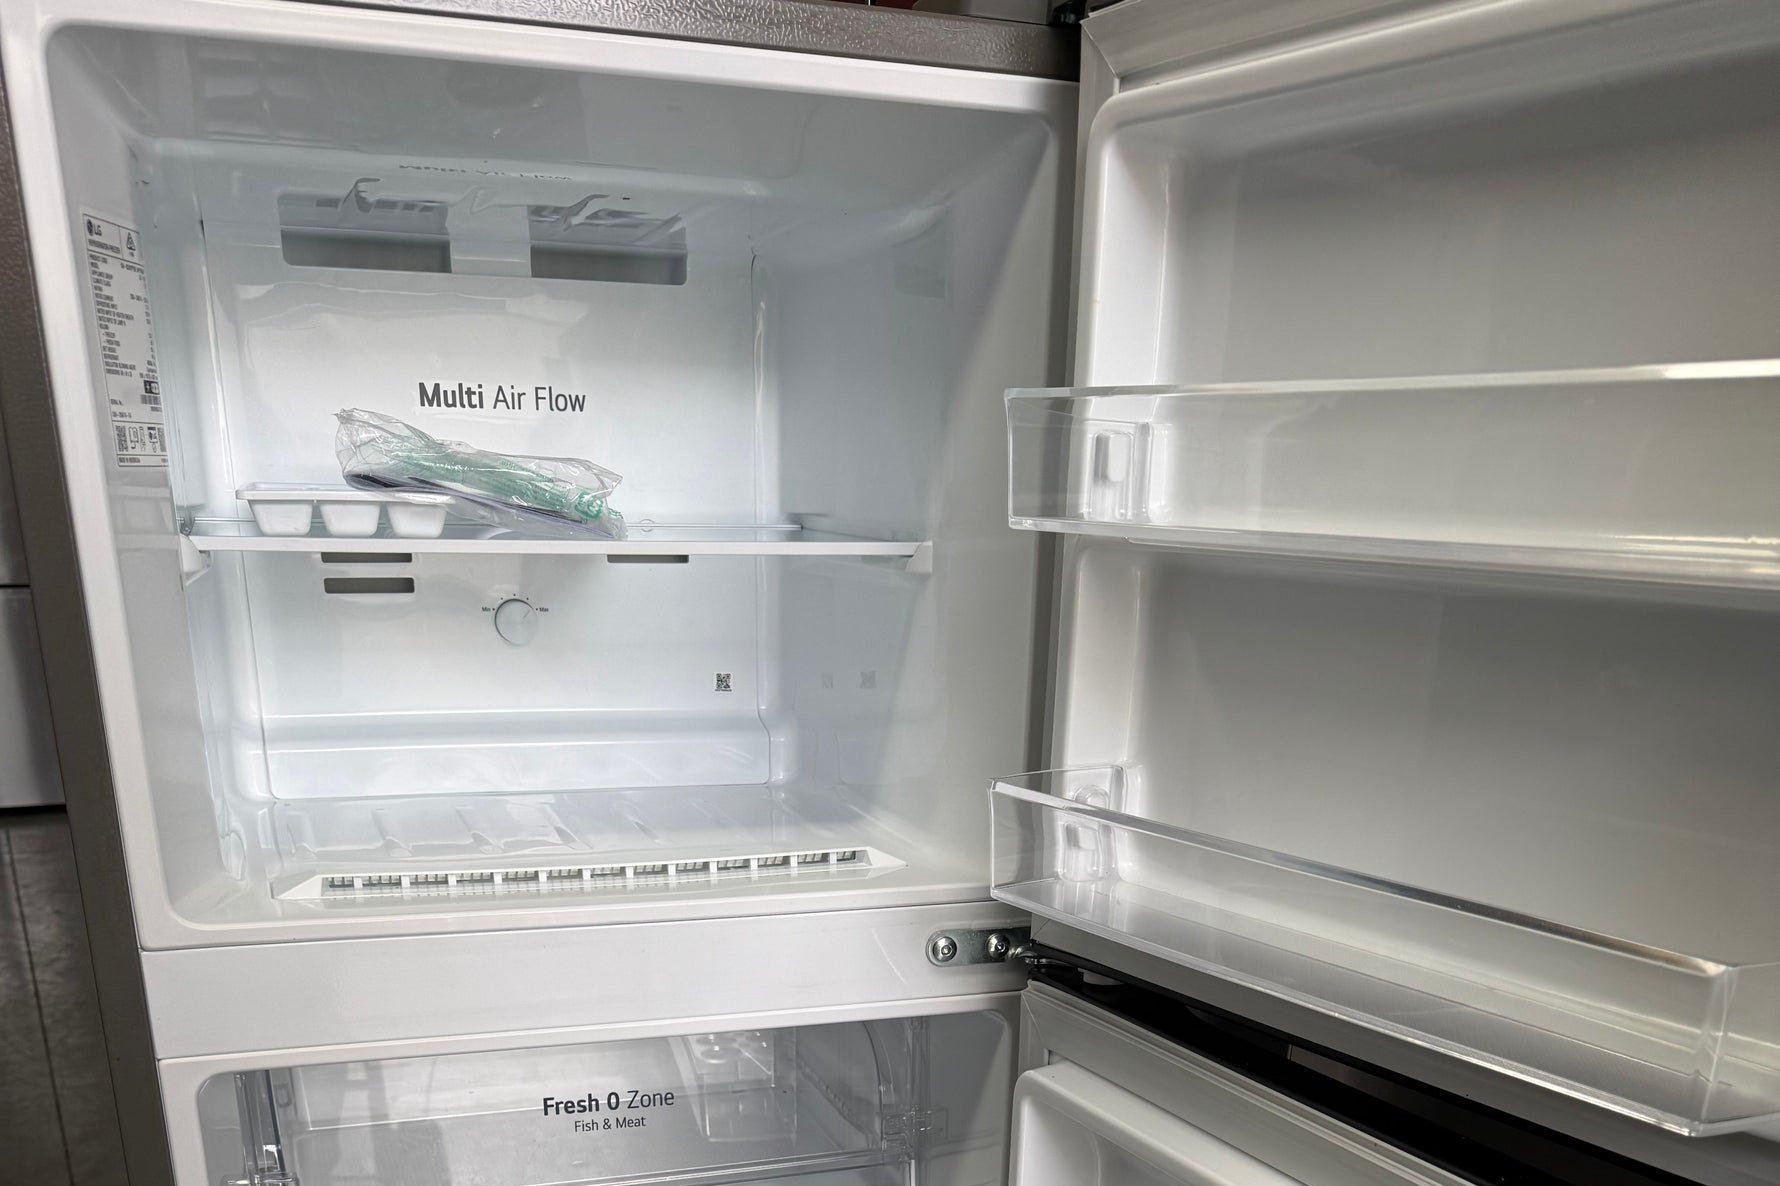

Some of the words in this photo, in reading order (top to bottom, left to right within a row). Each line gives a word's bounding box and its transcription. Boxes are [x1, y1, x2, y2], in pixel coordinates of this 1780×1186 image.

[418, 382, 484, 409] Multi
[493, 385, 526, 410] Air
[535, 386, 586, 412] Flow
[543, 1093, 600, 1116] Fresh
[627, 1090, 675, 1109] Zone
[574, 1119, 599, 1132] Fish
[602, 1118, 612, 1130] &
[615, 1116, 646, 1129] Meat
